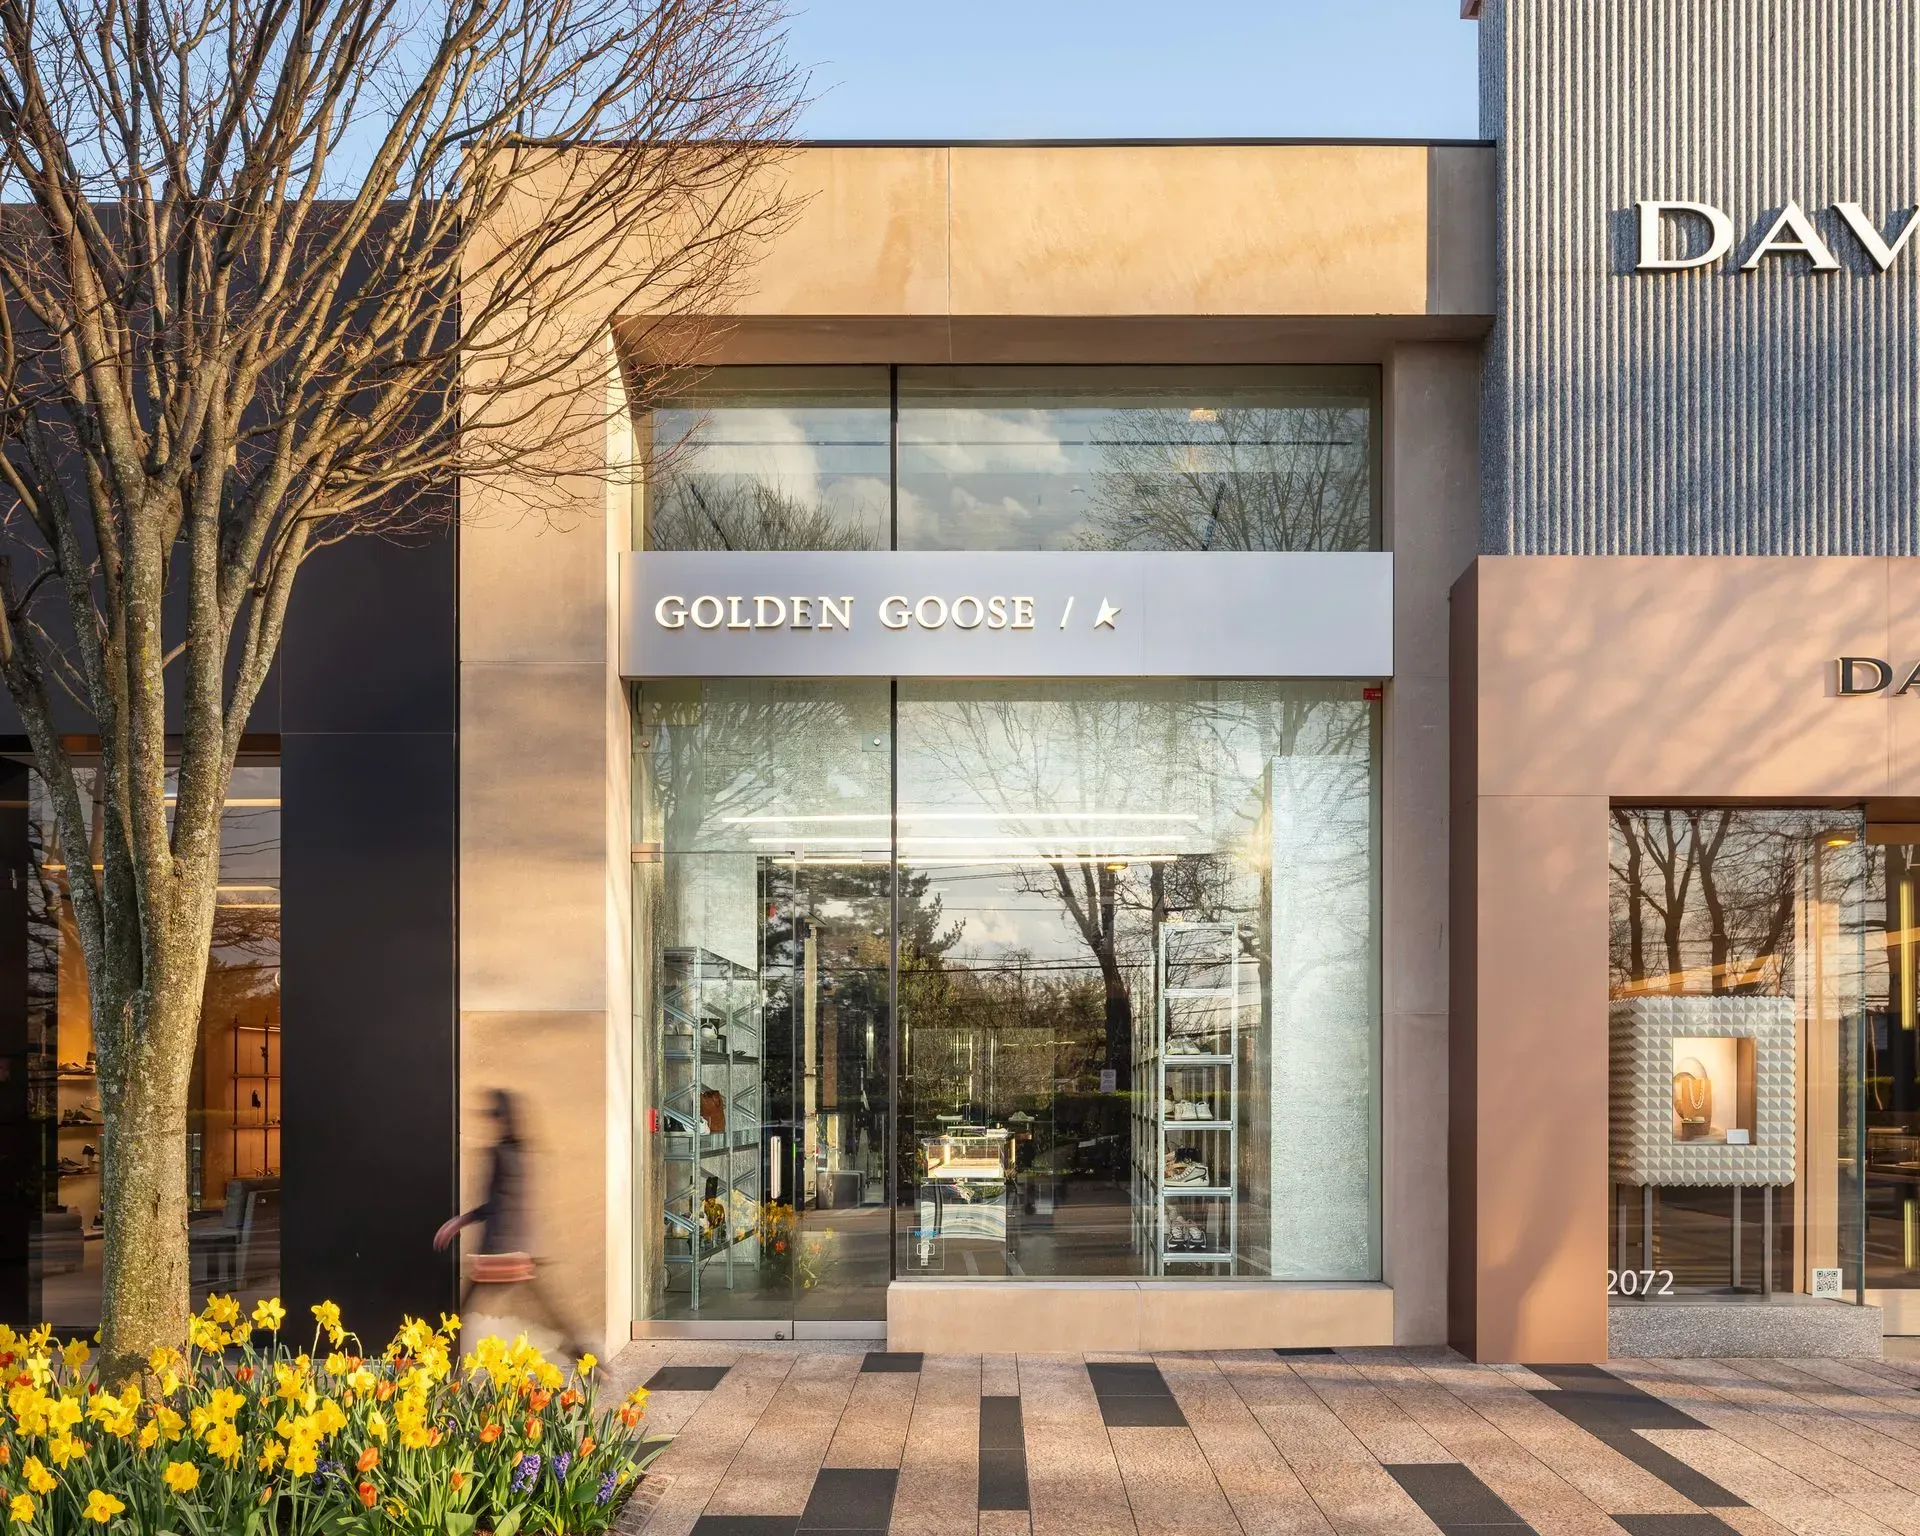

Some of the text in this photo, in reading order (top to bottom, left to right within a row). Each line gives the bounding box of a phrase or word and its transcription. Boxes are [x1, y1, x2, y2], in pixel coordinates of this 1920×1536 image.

[1635, 200, 1920, 271] DAV
[654, 595, 854, 630] GOLDEN
[878, 595, 1036, 629] GOOSE
[1607, 1269, 1674, 1295] 2072
